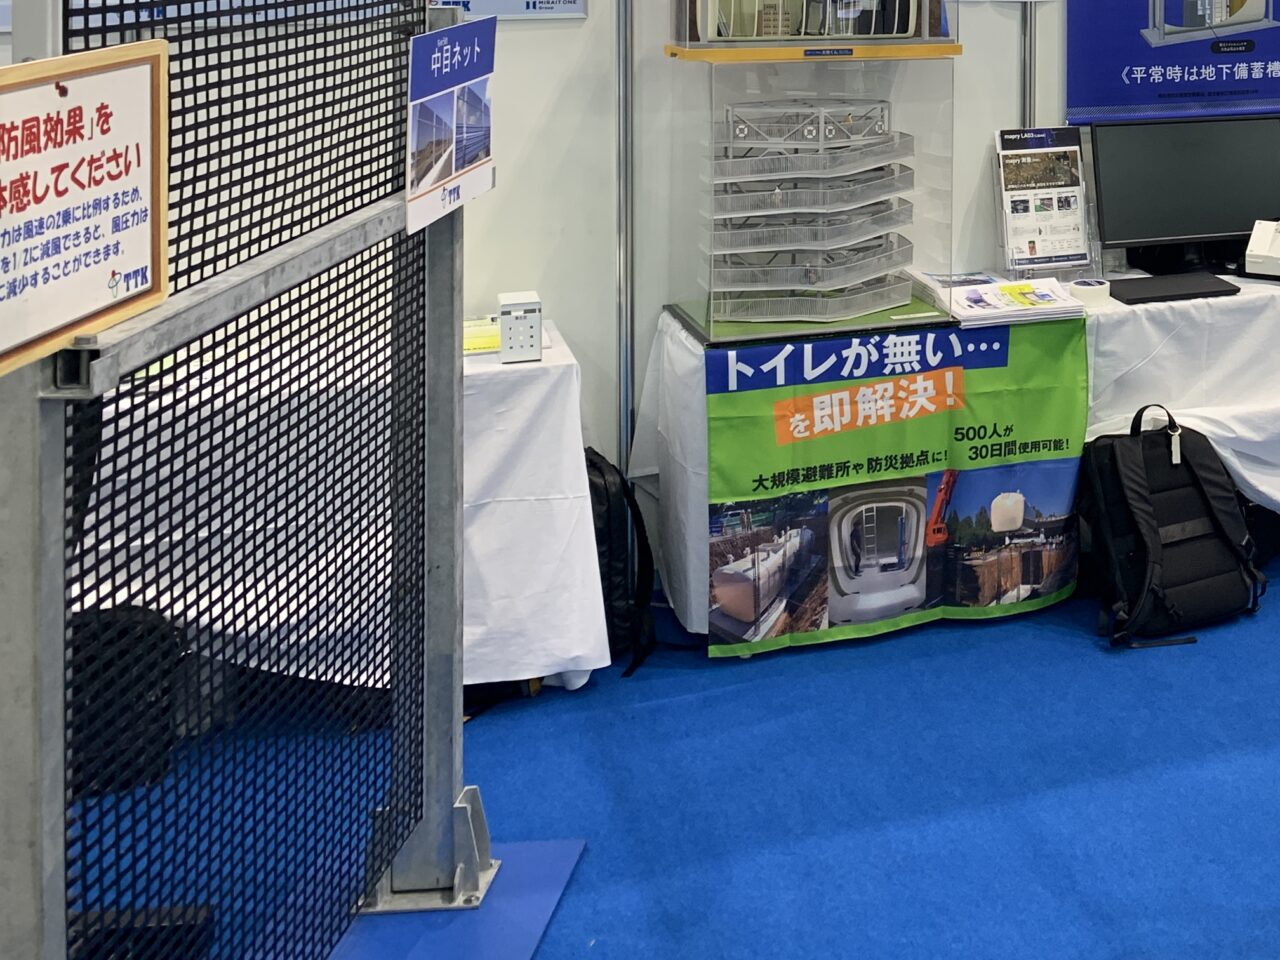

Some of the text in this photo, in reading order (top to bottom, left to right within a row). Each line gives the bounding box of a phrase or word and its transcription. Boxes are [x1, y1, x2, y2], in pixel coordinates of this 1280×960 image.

[431, 37, 481, 78] 中目ネット
[953, 422, 1015, 442] 500人が
